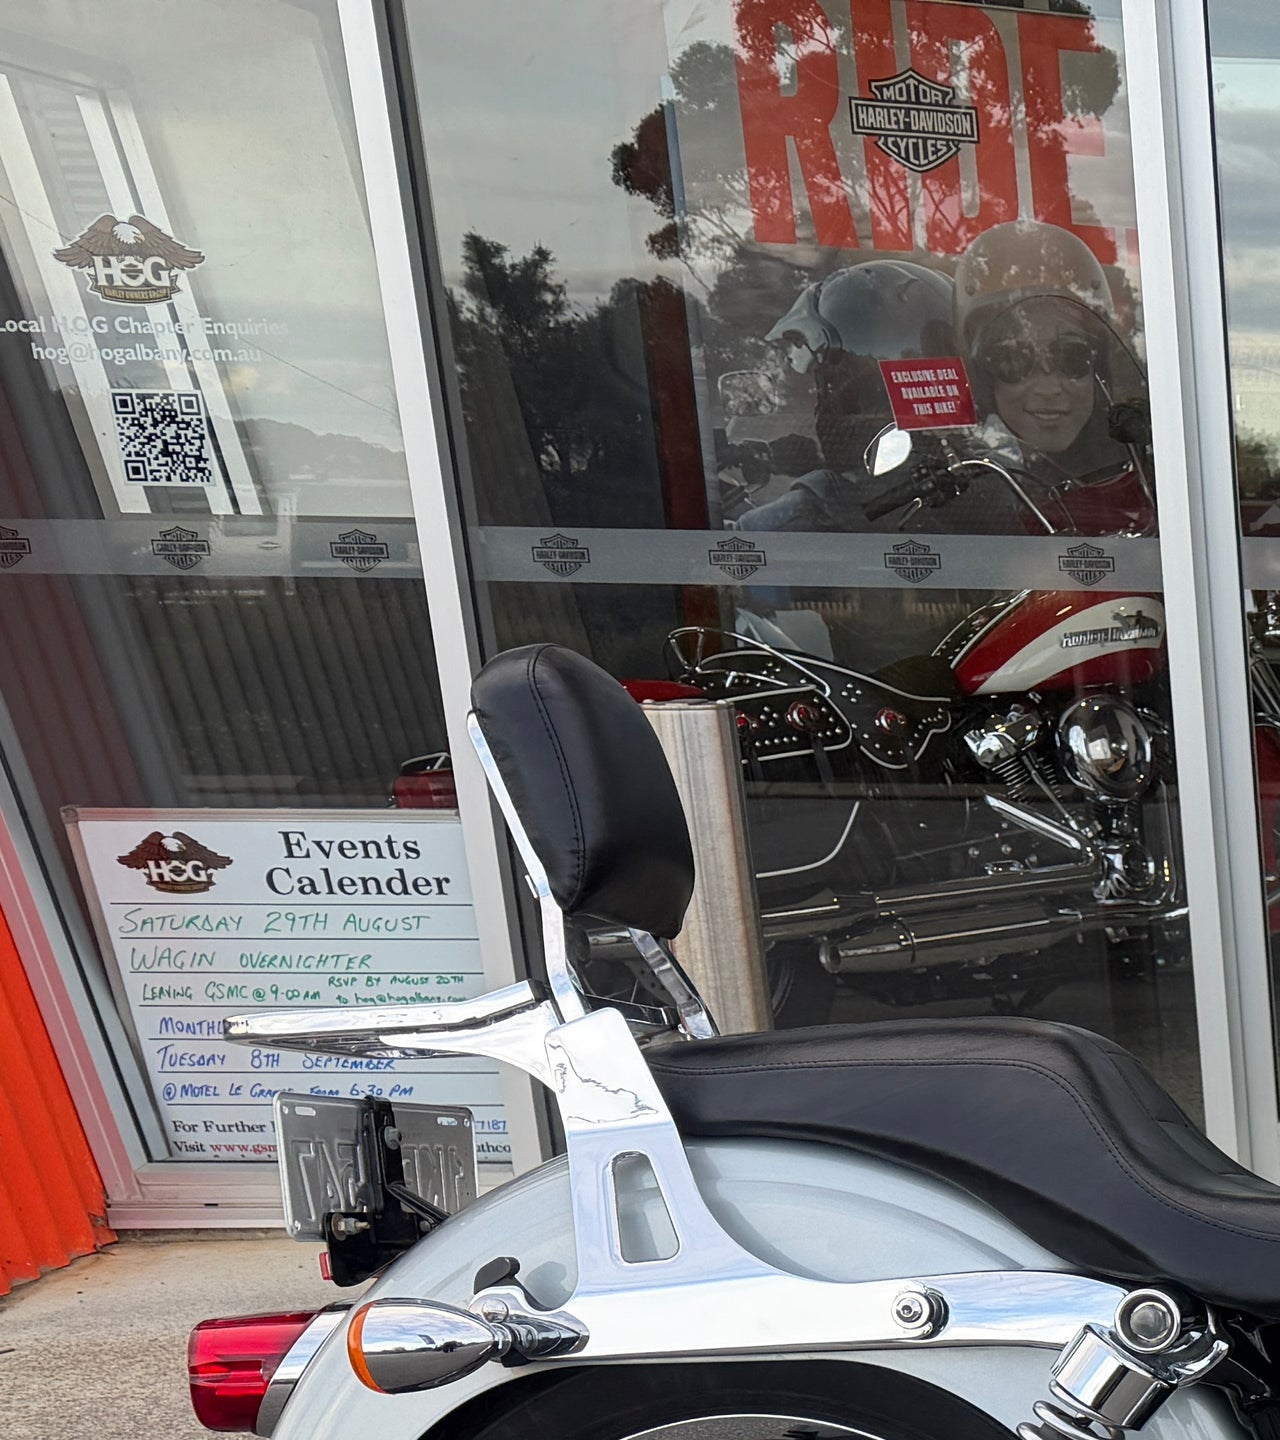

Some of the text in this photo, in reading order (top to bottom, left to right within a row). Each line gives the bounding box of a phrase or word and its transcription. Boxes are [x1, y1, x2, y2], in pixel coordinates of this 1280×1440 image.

[882, 79, 943, 104] MOTOR
[858, 106, 972, 135] HARLEY-DAVIDSON
[887, 137, 948, 165] CYCLES
[92, 256, 171, 287] HOG
[114, 317, 193, 337] Chapter
[203, 318, 289, 340] Enquiries
[891, 368, 959, 383] EXCLUSIVE DEAL
[901, 385, 946, 399] AVAILABLE
[913, 403, 933, 415] THIS
[278, 831, 421, 860] Events
[147, 861, 208, 883] HOG
[265, 867, 452, 896] Calender
[119, 908, 430, 935] SATURDAY 29TH AUGUST
[131, 947, 372, 971] WAGIN OVERNIGHTER
[328, 975, 464, 987] RSVP BY AUGUST 20TH
[143, 984, 193, 1001] LEAVING
[159, 1017, 225, 1035] MONTHL
[157, 1044, 396, 1071] TUESDAY 8TH SEPTEMBER
[180, 1083, 219, 1098] MOTEL
[229, 1083, 243, 1096] LE
[250, 1083, 293, 1098] GRA
[388, 1084, 413, 1096] PM
[172, 1120, 266, 1133] For Further
[172, 1140, 206, 1152] Visit
